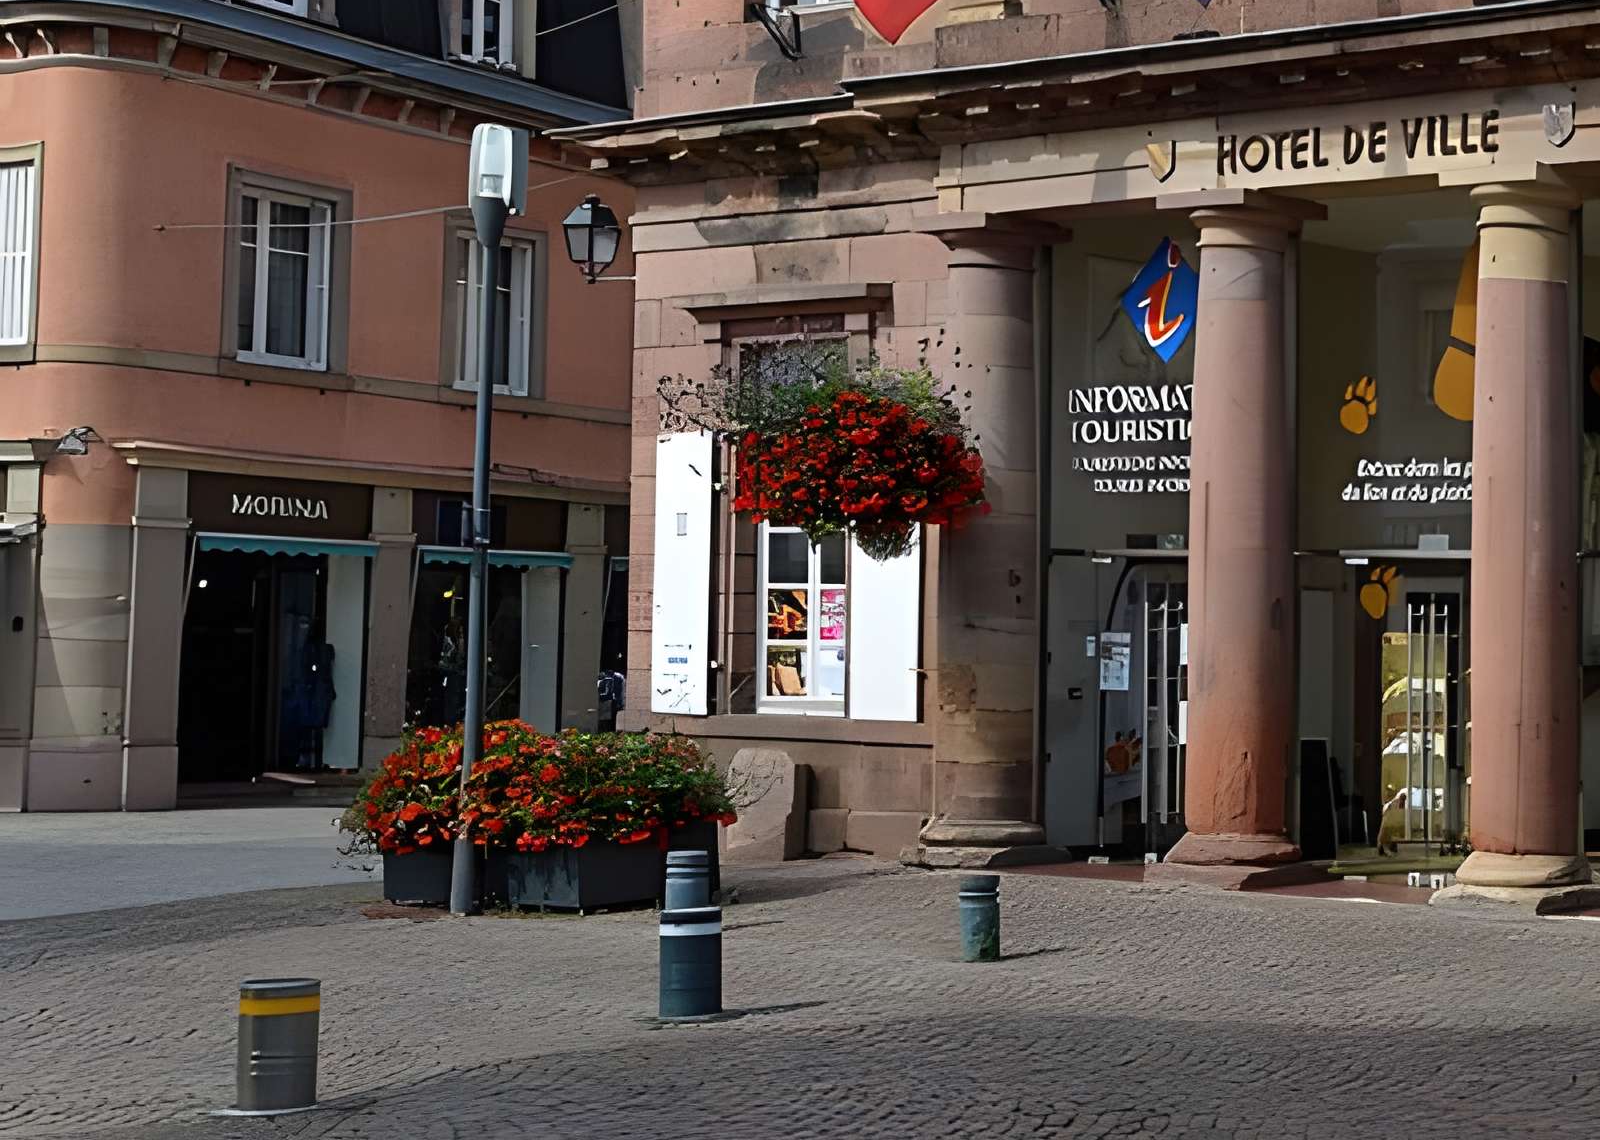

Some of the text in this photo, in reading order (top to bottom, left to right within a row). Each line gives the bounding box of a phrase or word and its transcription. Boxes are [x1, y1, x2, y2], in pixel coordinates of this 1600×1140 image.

[1217, 109, 1500, 176] HOTEL DE VILLE
[1072, 418, 1192, 444] TOURISTI
